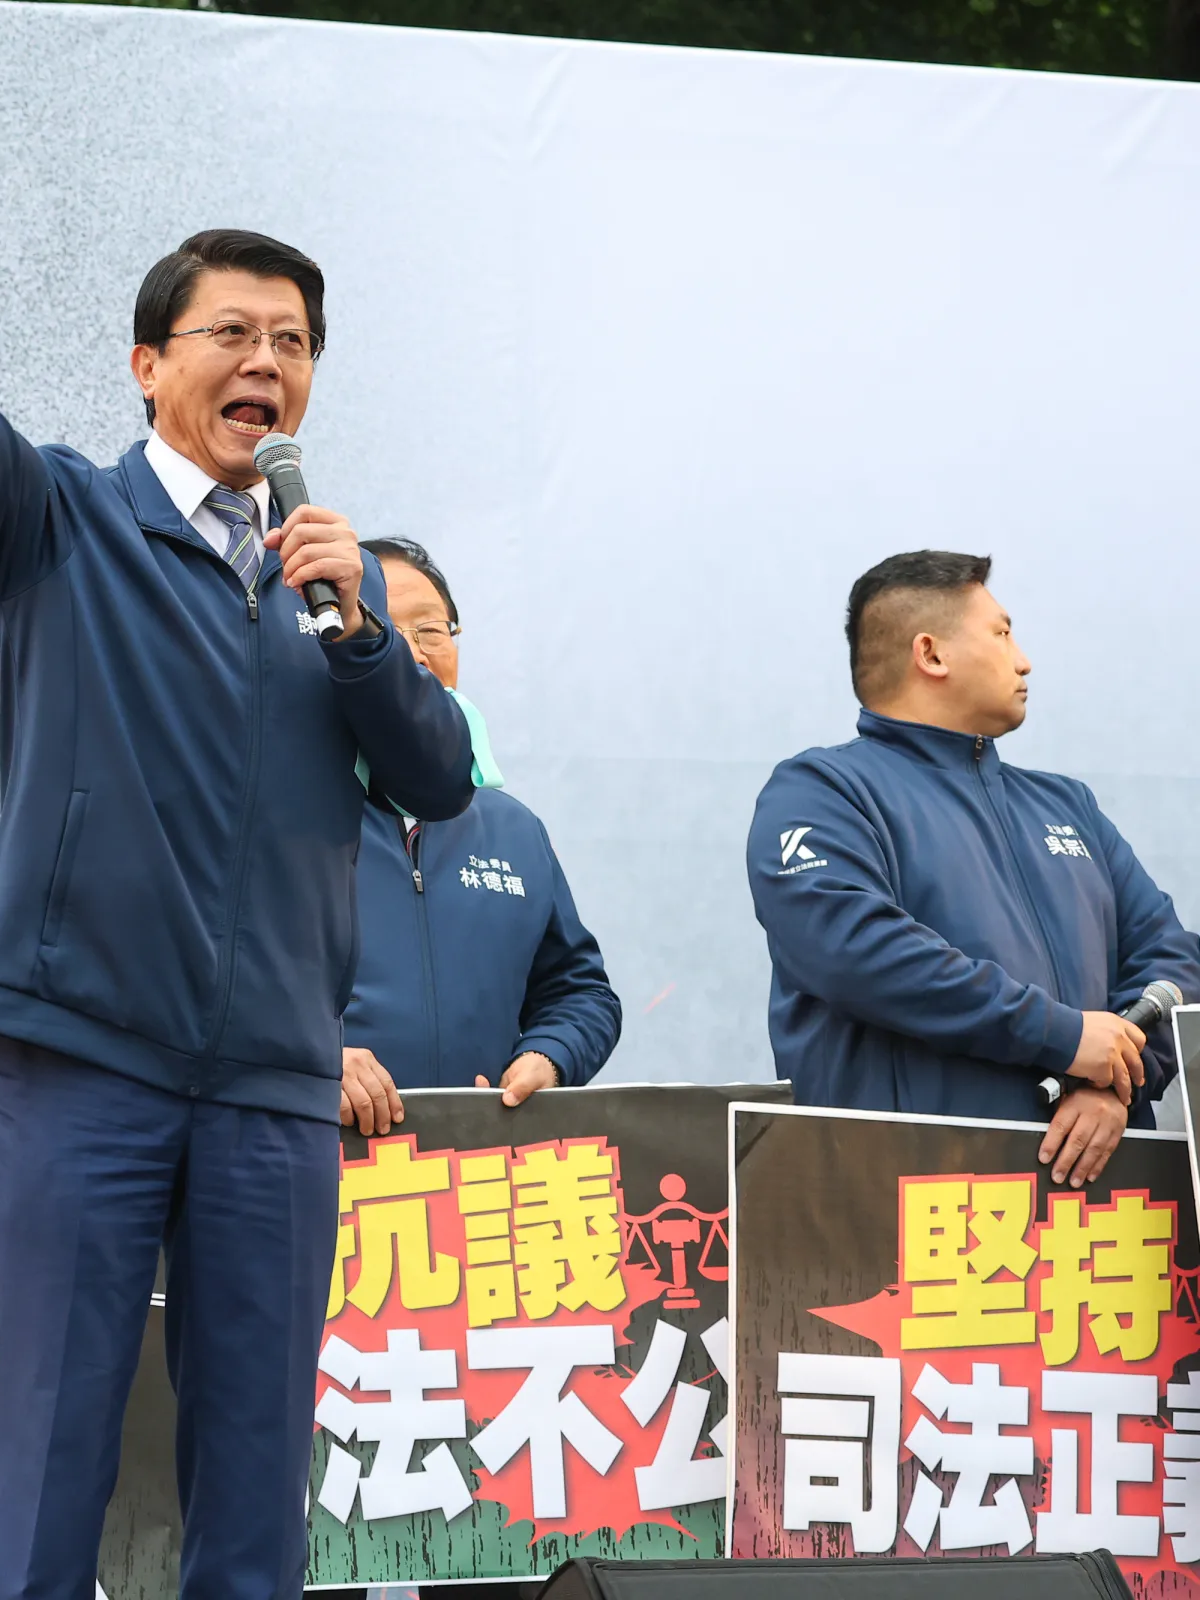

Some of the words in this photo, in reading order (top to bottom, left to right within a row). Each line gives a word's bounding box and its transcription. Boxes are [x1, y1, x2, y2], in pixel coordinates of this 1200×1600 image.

[459, 866, 526, 898] 林德福
[468, 854, 513, 874] 立法委員
[325, 1141, 628, 1328] 抗議
[900, 1180, 1173, 1367] 堅持
